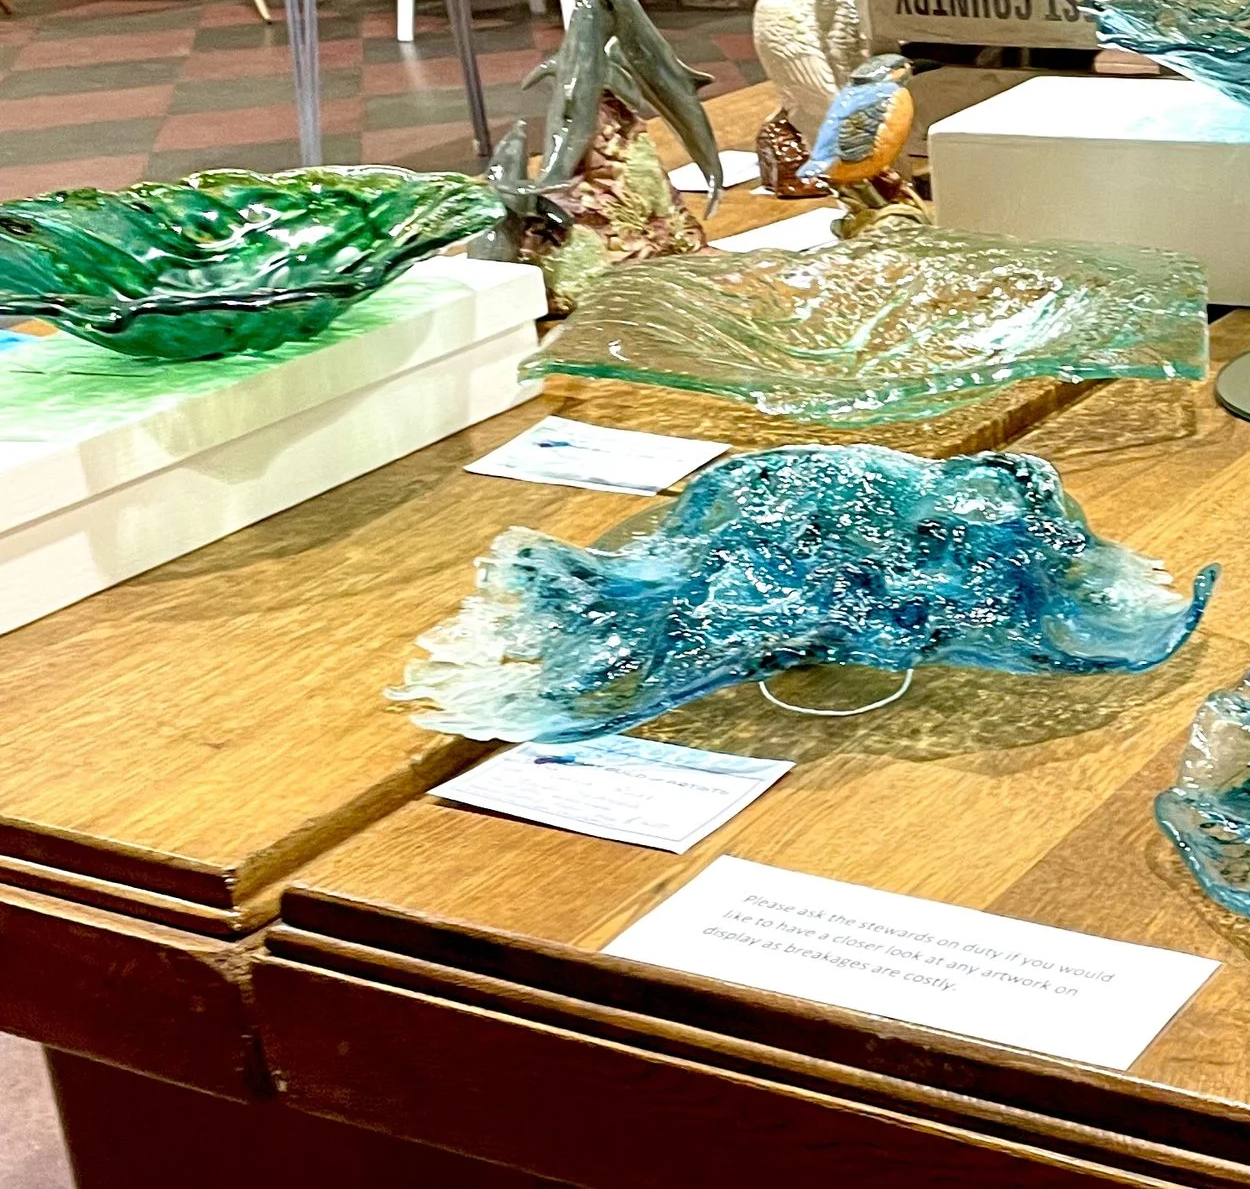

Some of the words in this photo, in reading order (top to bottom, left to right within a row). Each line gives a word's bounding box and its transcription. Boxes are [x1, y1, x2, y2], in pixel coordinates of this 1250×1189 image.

[701, 925, 762, 946] display
[760, 940, 783, 951] as
[782, 942, 870, 970] breakages
[869, 964, 901, 978] are
[901, 971, 956, 992] costly.
[721, 909, 753, 923] like
[753, 916, 774, 928] to
[774, 920, 817, 937] have
[816, 932, 830, 941] a
[831, 934, 884, 951] closer
[884, 944, 922, 961] look
[923, 955, 945, 966] at
[944, 960, 980, 975] any
[979, 968, 1051, 990] artwork
[1053, 985, 1079, 996] on
[742, 894, 796, 913] Please
[795, 907, 824, 919] ask
[826, 913, 857, 926] the
[856, 921, 935, 943] stewards
[935, 938, 960, 949] on
[961, 942, 1004, 960] duty
[1003, 952, 1020, 962] if
[1019, 956, 1055, 970] you
[1057, 964, 1116, 983] would
